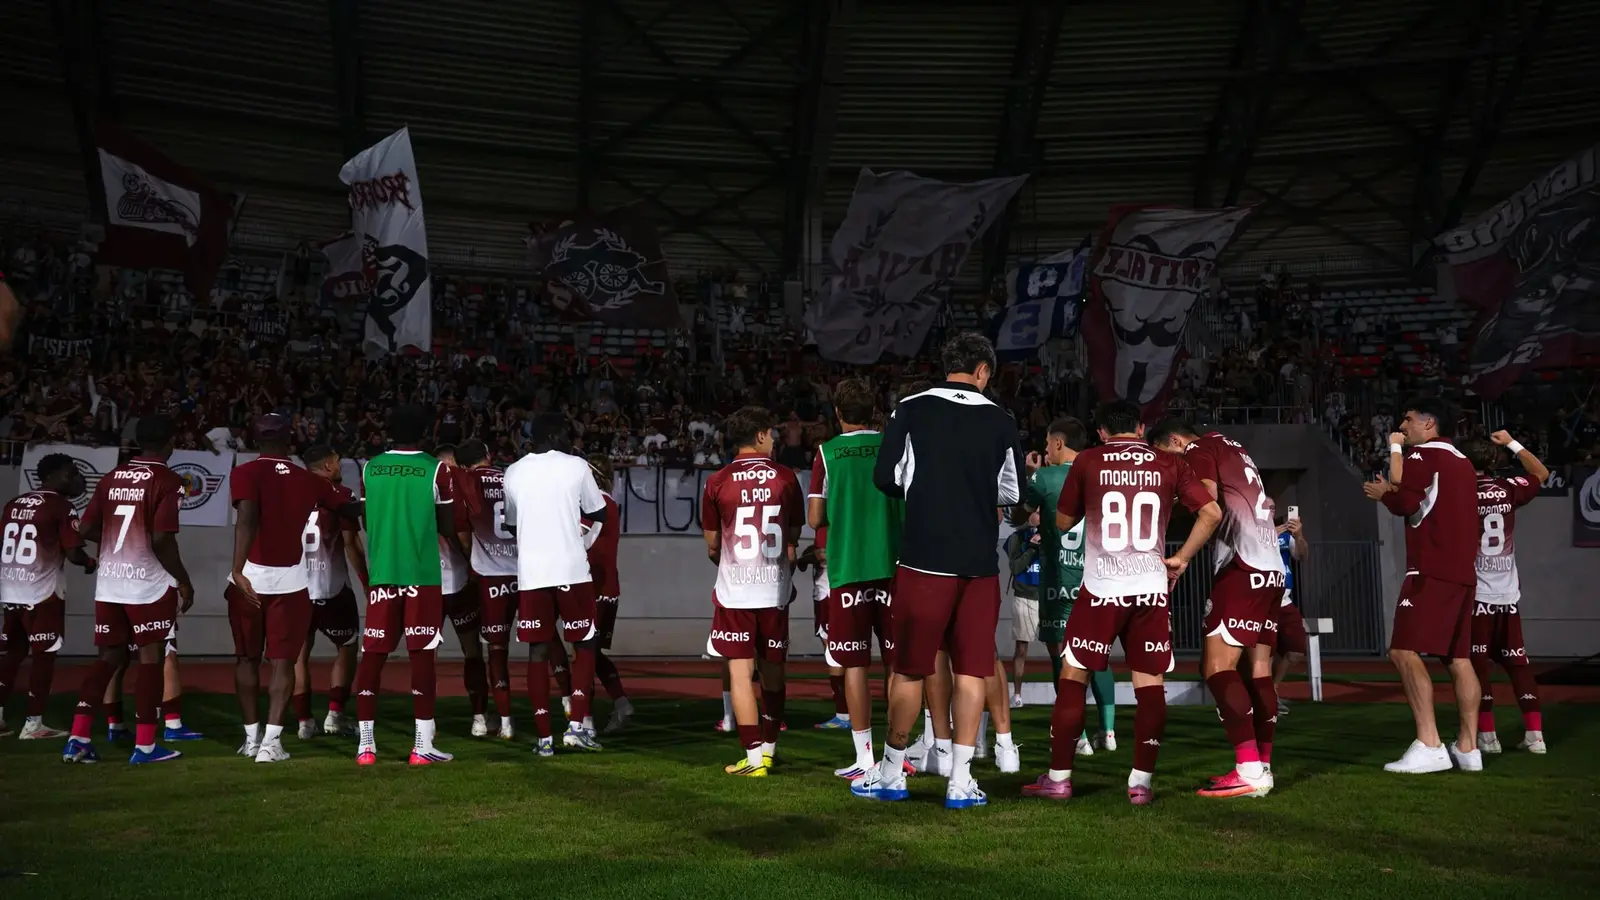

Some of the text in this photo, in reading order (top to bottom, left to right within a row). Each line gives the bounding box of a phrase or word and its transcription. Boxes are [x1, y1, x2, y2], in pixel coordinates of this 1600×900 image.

[1103, 452, 1155, 466] mogo
[114, 469, 152, 484] mogo
[732, 469, 777, 485] mogo
[108, 488, 145, 502] KAMARA
[741, 488, 771, 503] R. POP
[1244, 467, 1270, 521] 2
[15, 497, 43, 507] mogo
[1102, 491, 1161, 552] 80
[113, 505, 136, 554] 7
[733, 505, 783, 560] 55
[1481, 513, 1505, 556] 8
[1, 522, 38, 565] 66
[1471, 602, 1518, 616] ACRIS
[133, 619, 171, 635] DACRIS
[405, 626, 435, 636] DACRIS
[563, 618, 590, 630] ACRIS
[711, 630, 750, 642] DACRIS
[829, 640, 868, 651] DACRIS
